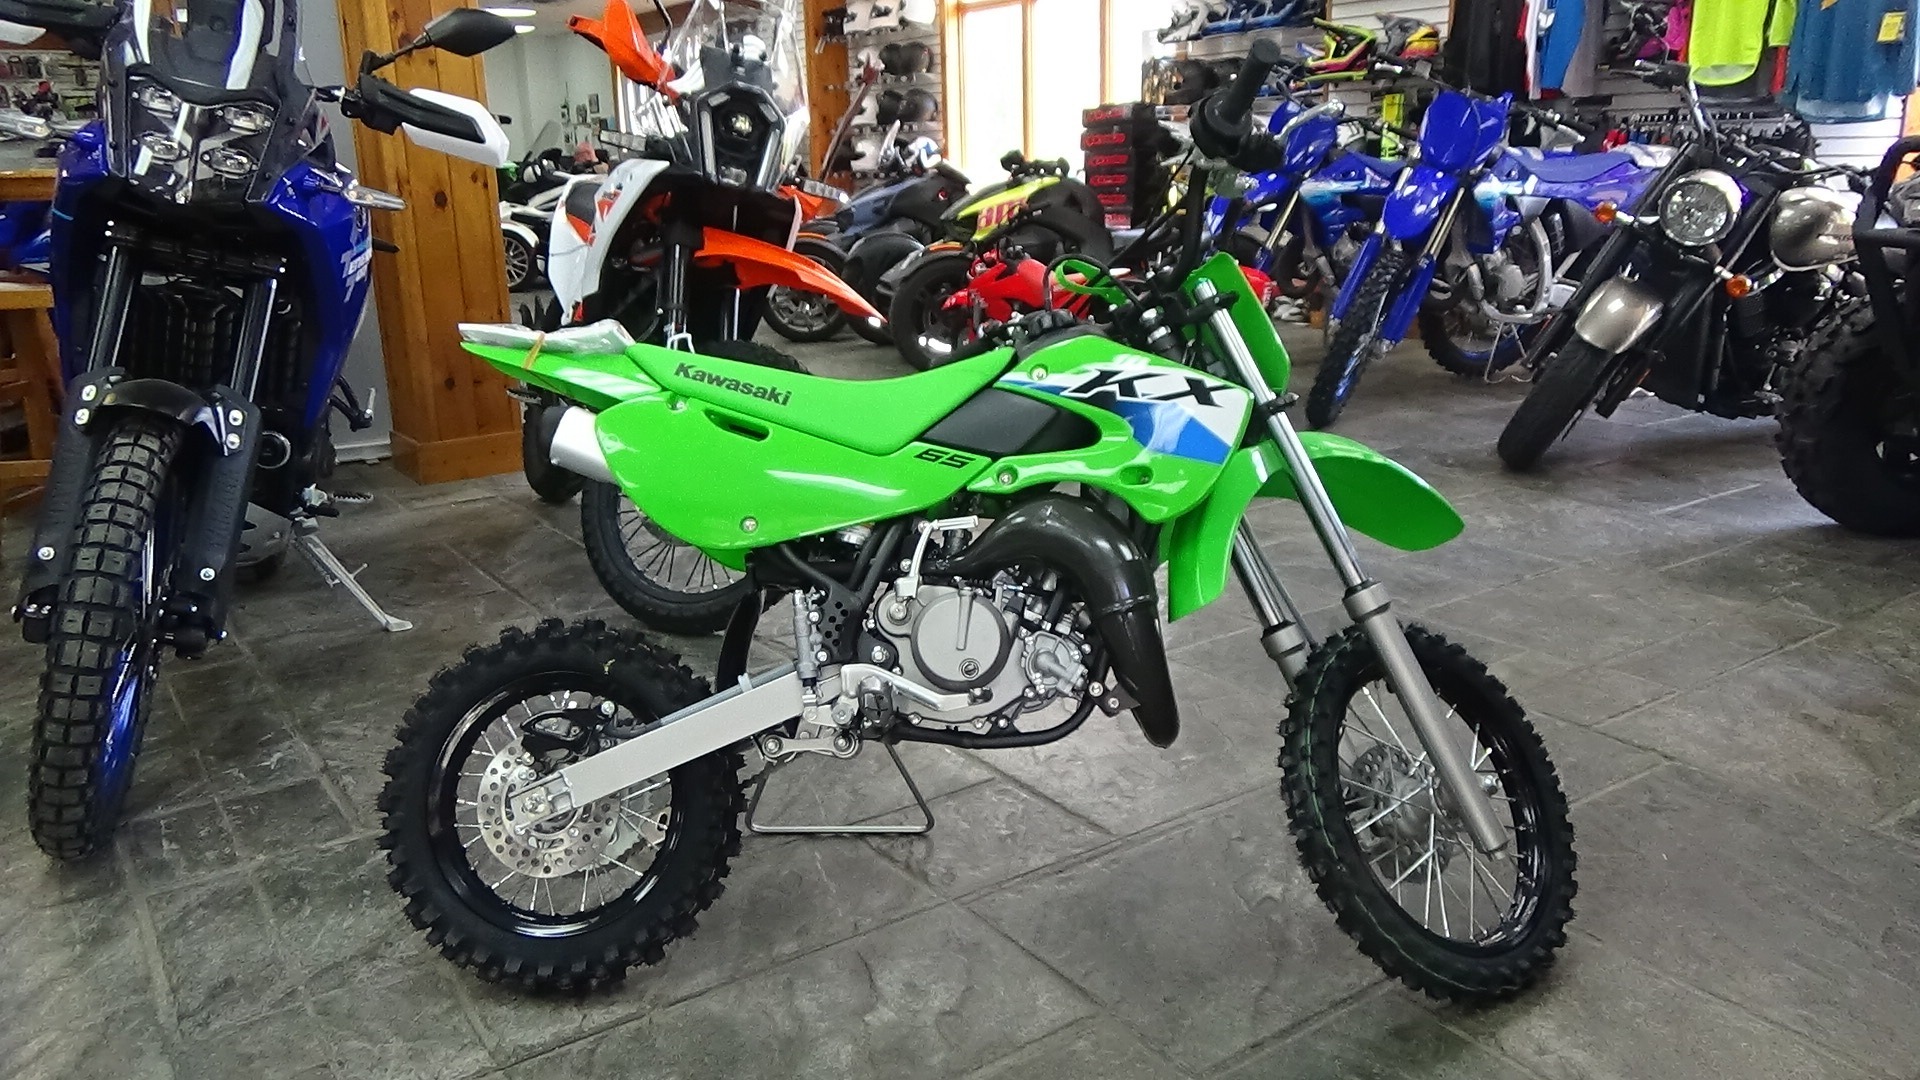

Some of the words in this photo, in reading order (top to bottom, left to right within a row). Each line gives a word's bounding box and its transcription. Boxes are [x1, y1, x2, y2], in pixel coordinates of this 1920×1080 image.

[674, 362, 792, 406] Kawasaki
[1067, 368, 1236, 408] KX
[913, 447, 977, 469] 65
